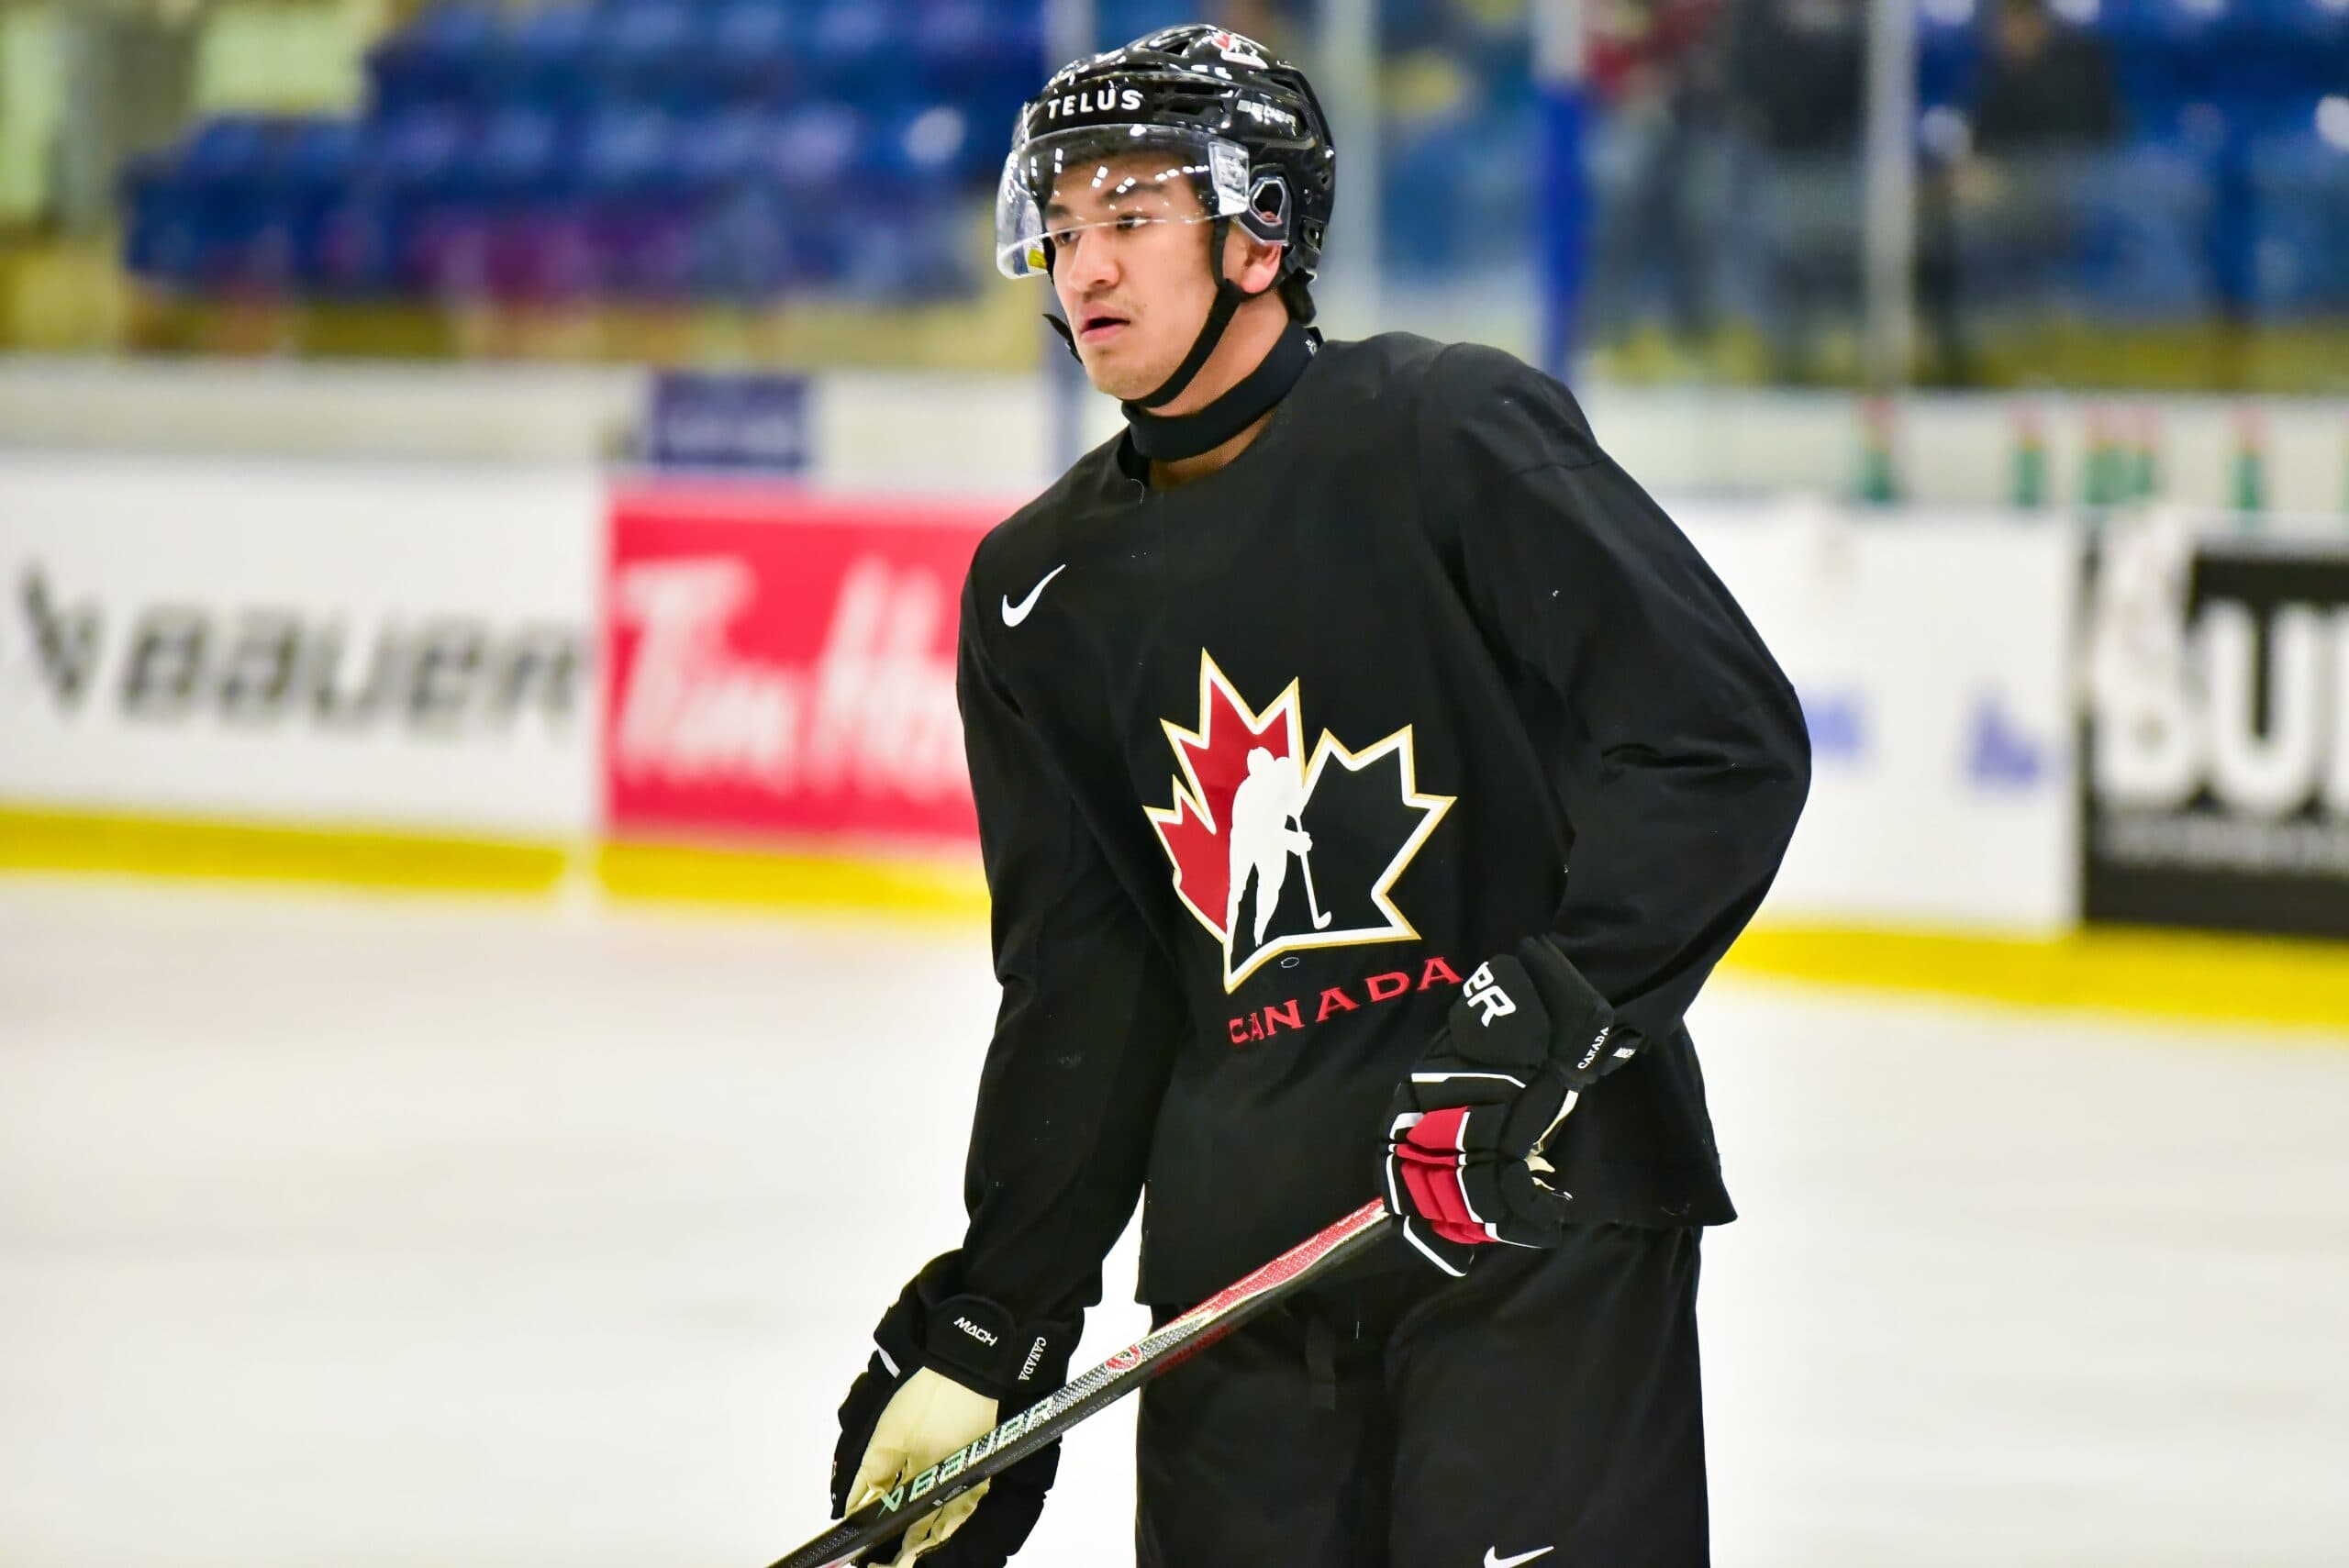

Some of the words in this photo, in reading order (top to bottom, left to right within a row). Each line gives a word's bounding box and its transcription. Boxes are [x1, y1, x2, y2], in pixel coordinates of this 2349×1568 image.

[1047, 88, 1145, 119] TELUS
[1228, 956, 1464, 1044] CANADA
[1577, 1027, 1609, 1069] CANADA
[953, 1317, 998, 1347] MACH
[1018, 1336, 1047, 1381] CANADA
[908, 1394, 1057, 1503] BAUER
